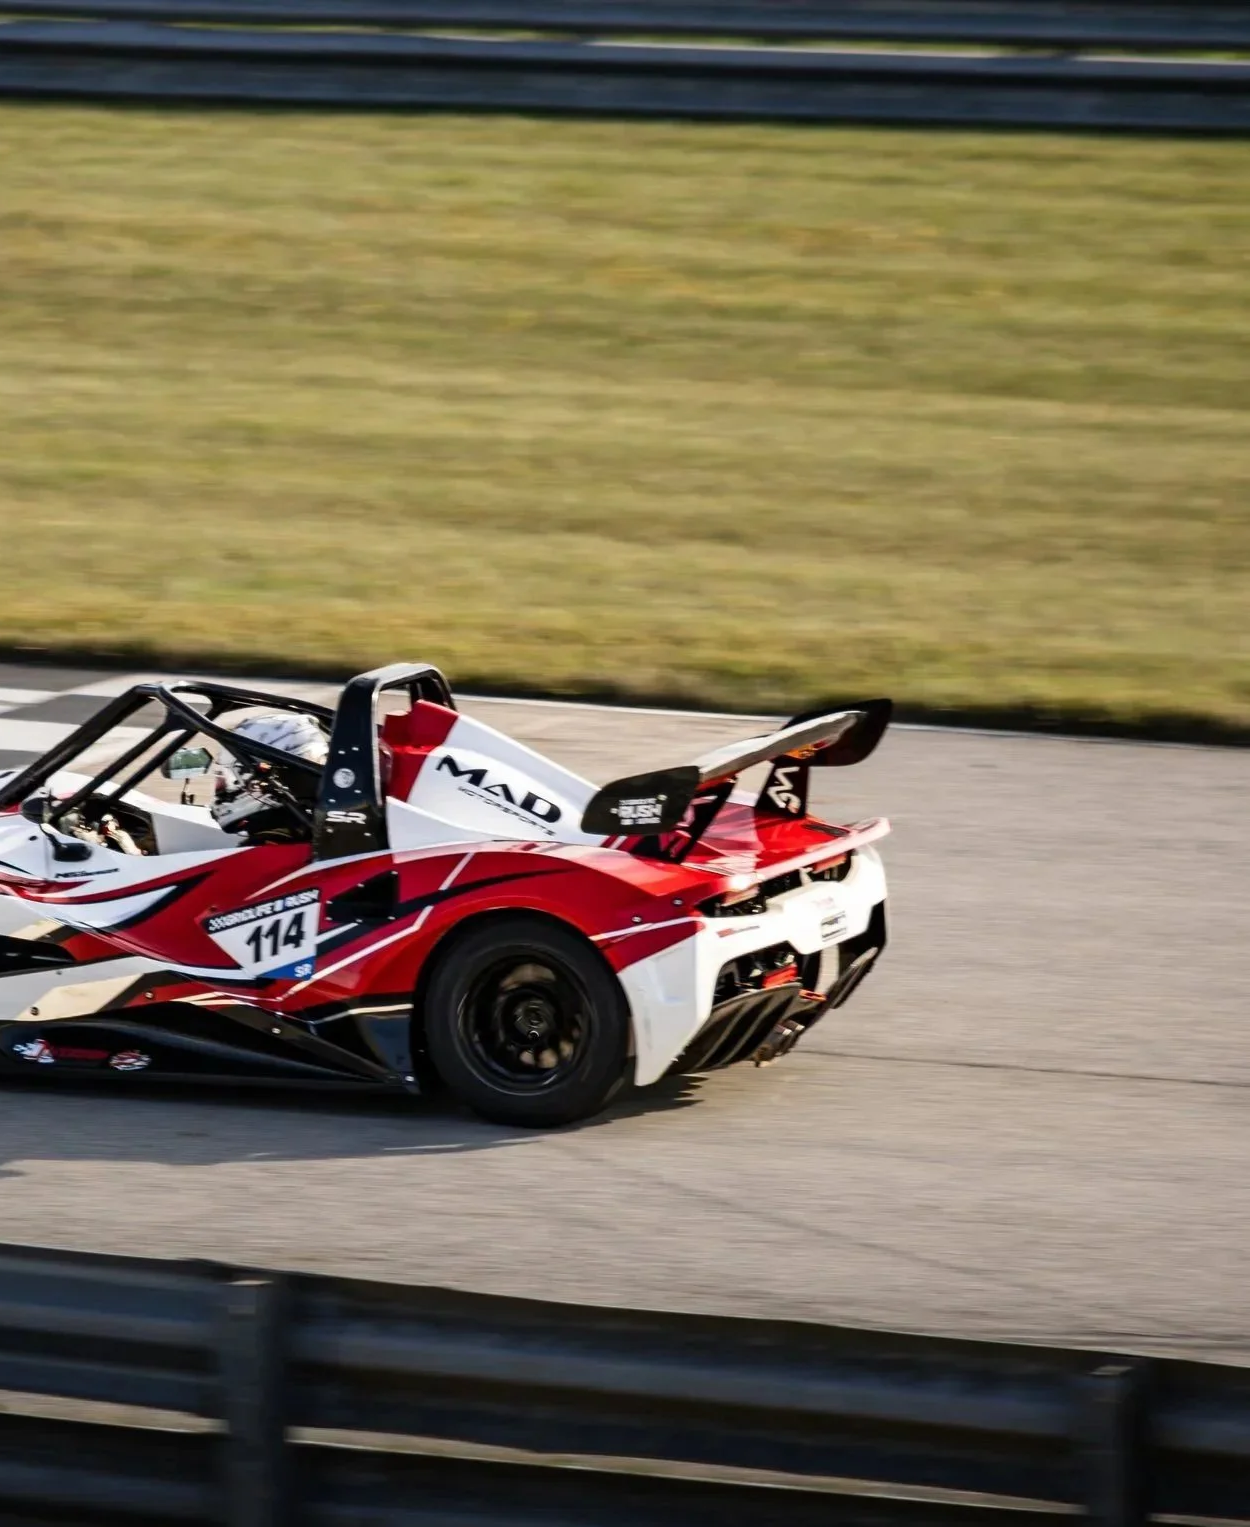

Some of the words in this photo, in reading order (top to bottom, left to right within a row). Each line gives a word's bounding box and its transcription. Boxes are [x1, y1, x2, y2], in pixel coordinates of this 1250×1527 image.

[435, 755, 562, 823] MAD
[325, 810, 367, 825] SR
[618, 804, 662, 819] RUSH
[246, 911, 307, 963] 114
[294, 963, 312, 978] SR
